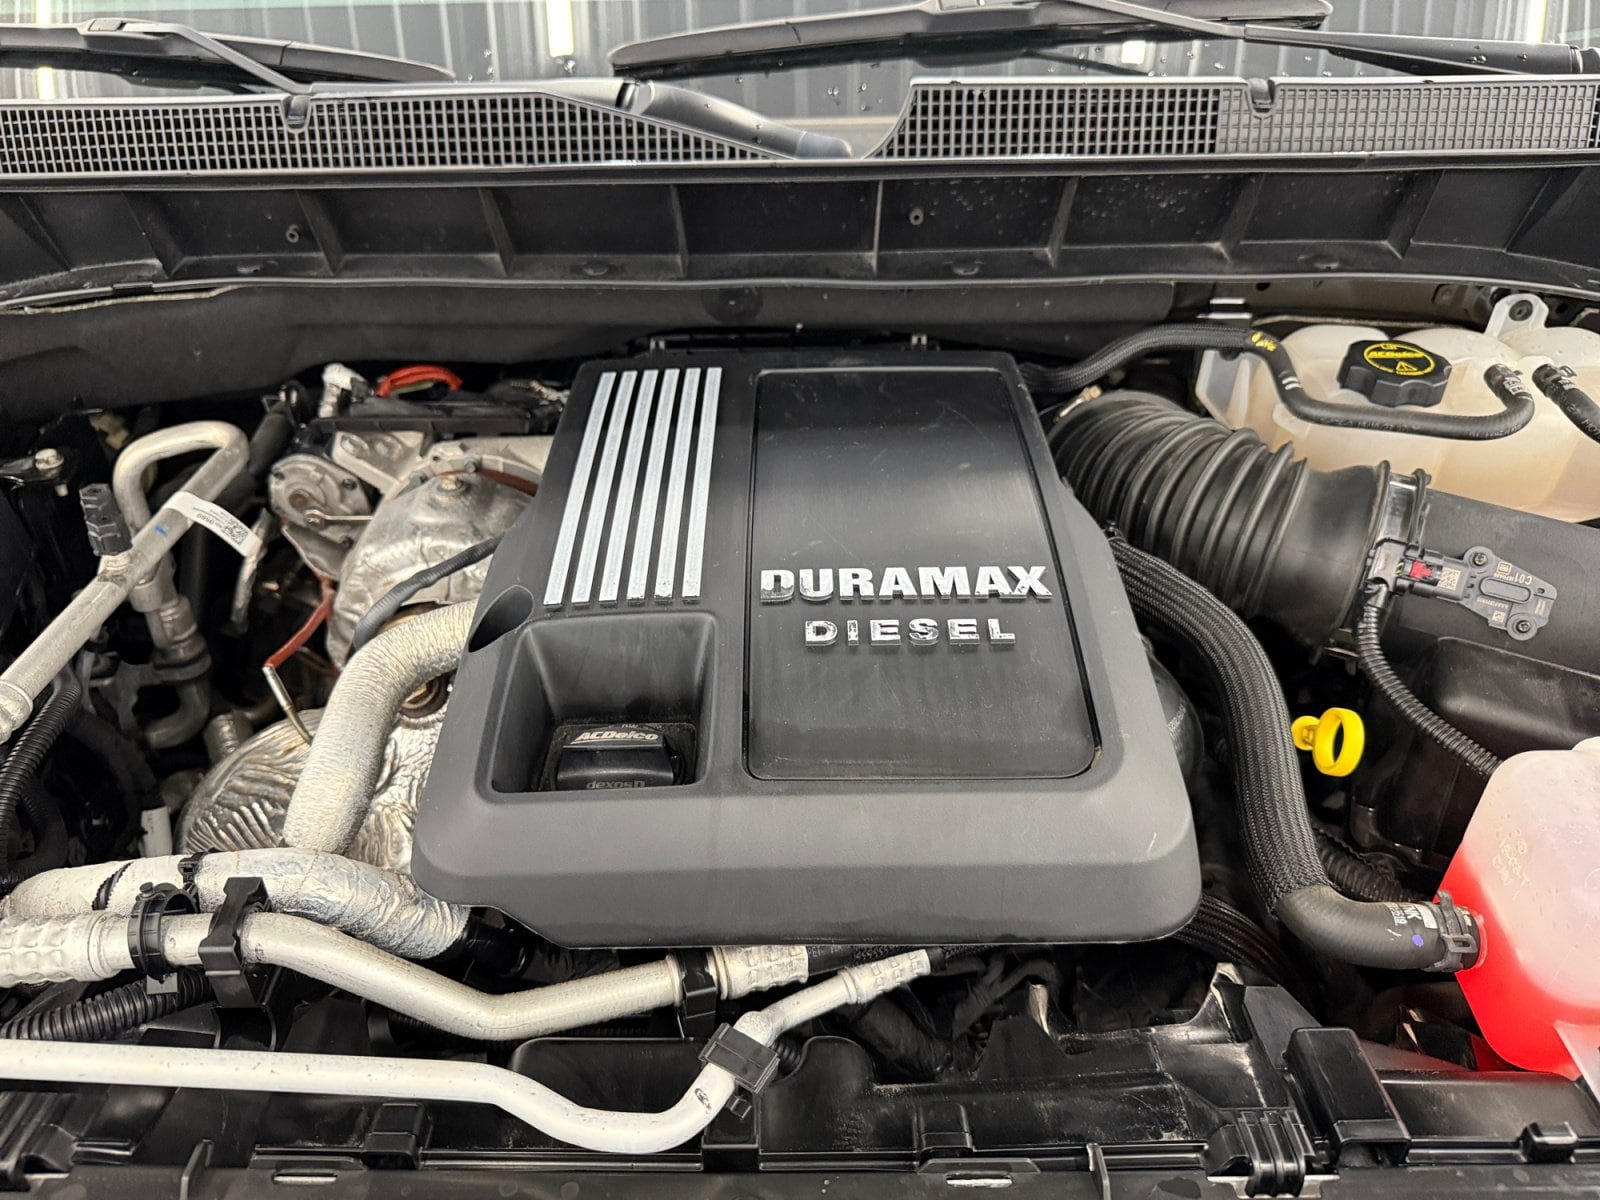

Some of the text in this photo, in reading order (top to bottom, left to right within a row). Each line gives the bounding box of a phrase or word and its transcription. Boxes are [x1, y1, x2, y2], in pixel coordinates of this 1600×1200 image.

[760, 565, 1053, 602] DURAMAX
[804, 617, 1016, 645] DIESEL
[575, 730, 659, 741] ACDelco
